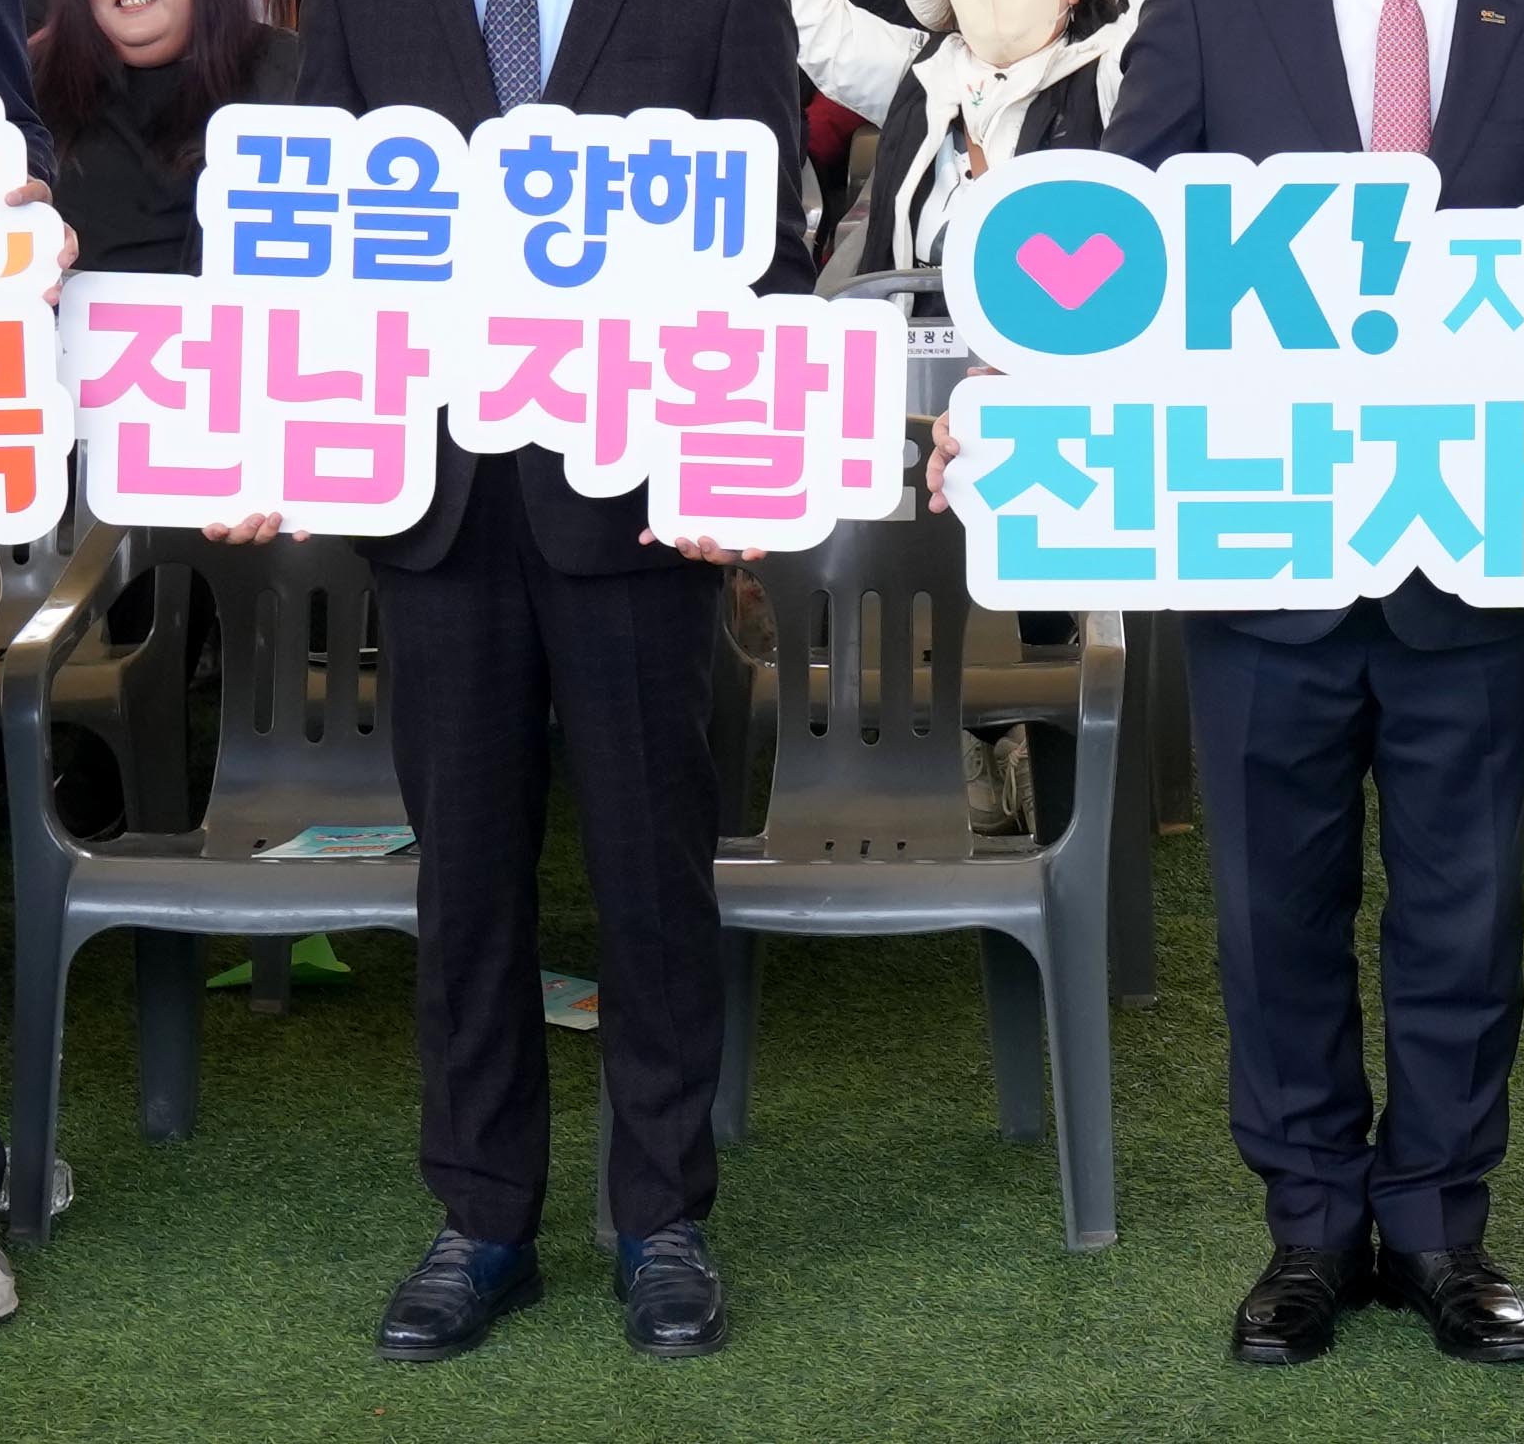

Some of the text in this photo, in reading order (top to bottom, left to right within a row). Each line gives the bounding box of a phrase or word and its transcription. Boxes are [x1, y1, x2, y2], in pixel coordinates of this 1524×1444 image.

[228, 135, 747, 288] 꿈을 향해
[973, 180, 1412, 356] OK!
[80, 302, 877, 520] 전남 자활!
